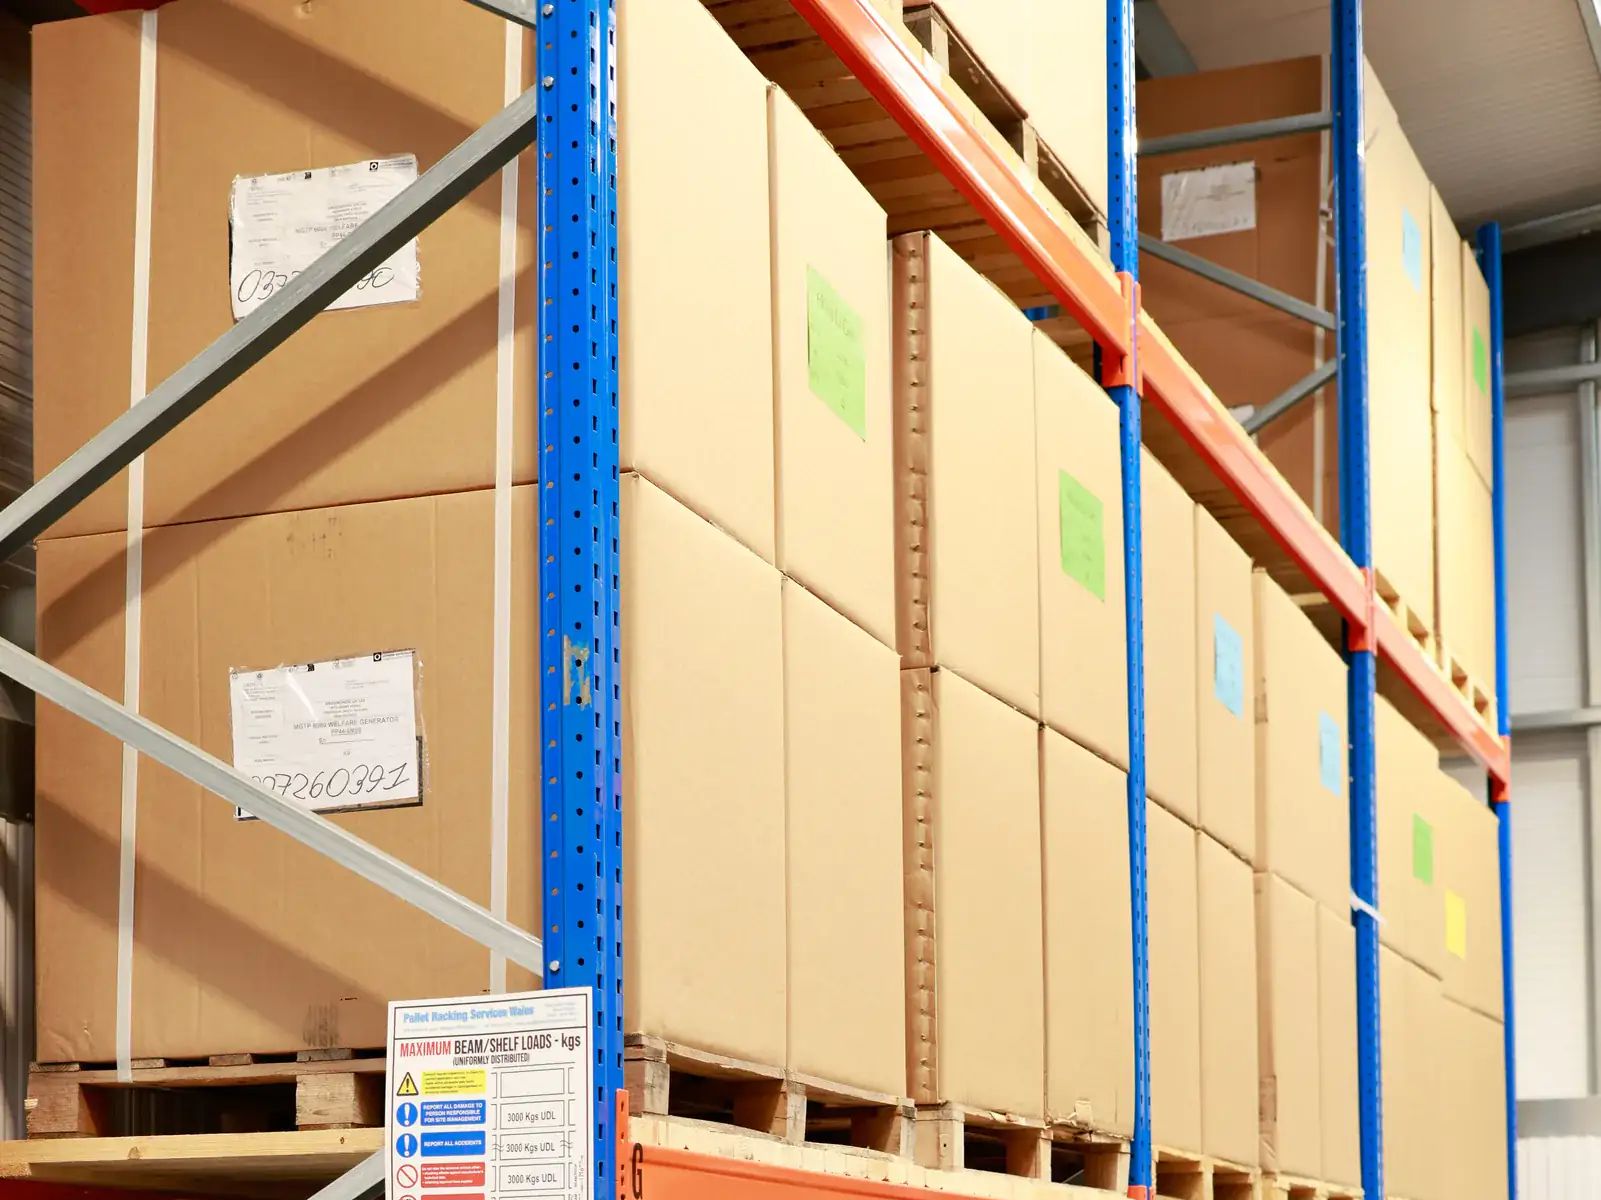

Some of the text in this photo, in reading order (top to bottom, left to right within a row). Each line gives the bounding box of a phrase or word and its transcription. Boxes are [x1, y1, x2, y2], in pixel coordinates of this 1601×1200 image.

[328, 719, 357, 728] WELFARE
[359, 716, 399, 726] GENERATOR
[252, 762, 409, 799] 7260391
[403, 1012, 429, 1024] Pallet
[431, 1010, 468, 1023] Racking
[470, 1007, 507, 1020] Services
[509, 1005, 534, 1017] Wales
[400, 1041, 451, 1057] MAXIMUM
[454, 1036, 519, 1055] BEAM/SHELF
[522, 1034, 551, 1051] LOADS
[561, 1032, 581, 1051] kgs
[453, 1053, 530, 1067] (UNIFORMLY DISTRIBUTED)
[507, 1111, 556, 1123] 3000 Kgs UDL
[506, 1142, 555, 1154] 3000 Kgs UDL
[632, 1143, 643, 1200] G
[507, 1173, 557, 1185] 3000 Kgs UDL
